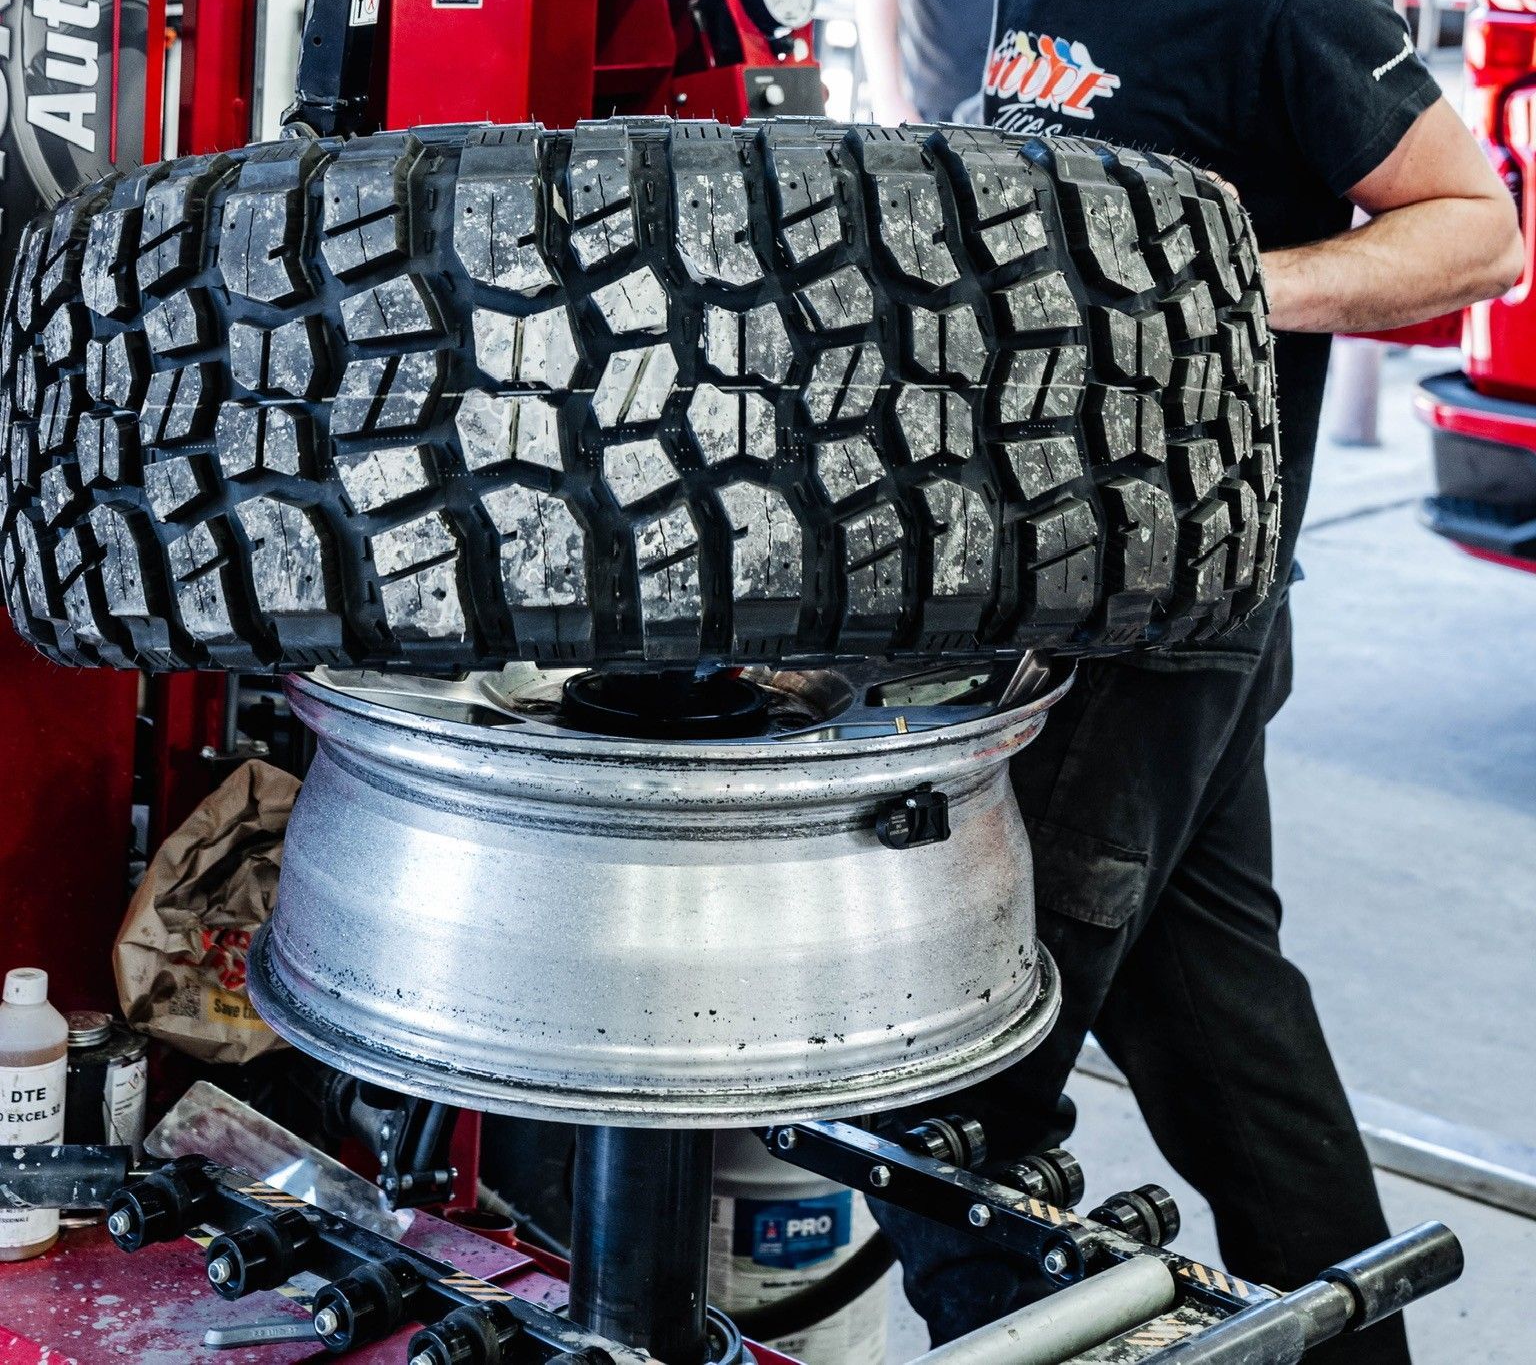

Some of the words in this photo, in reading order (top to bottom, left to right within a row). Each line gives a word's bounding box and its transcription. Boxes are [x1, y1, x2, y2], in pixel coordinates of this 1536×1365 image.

[995, 103, 1063, 138] Tires
[11, 1087, 46, 1103] DTE
[8, 1110, 48, 1122] EXCEL
[786, 1215, 833, 1237] PRO
